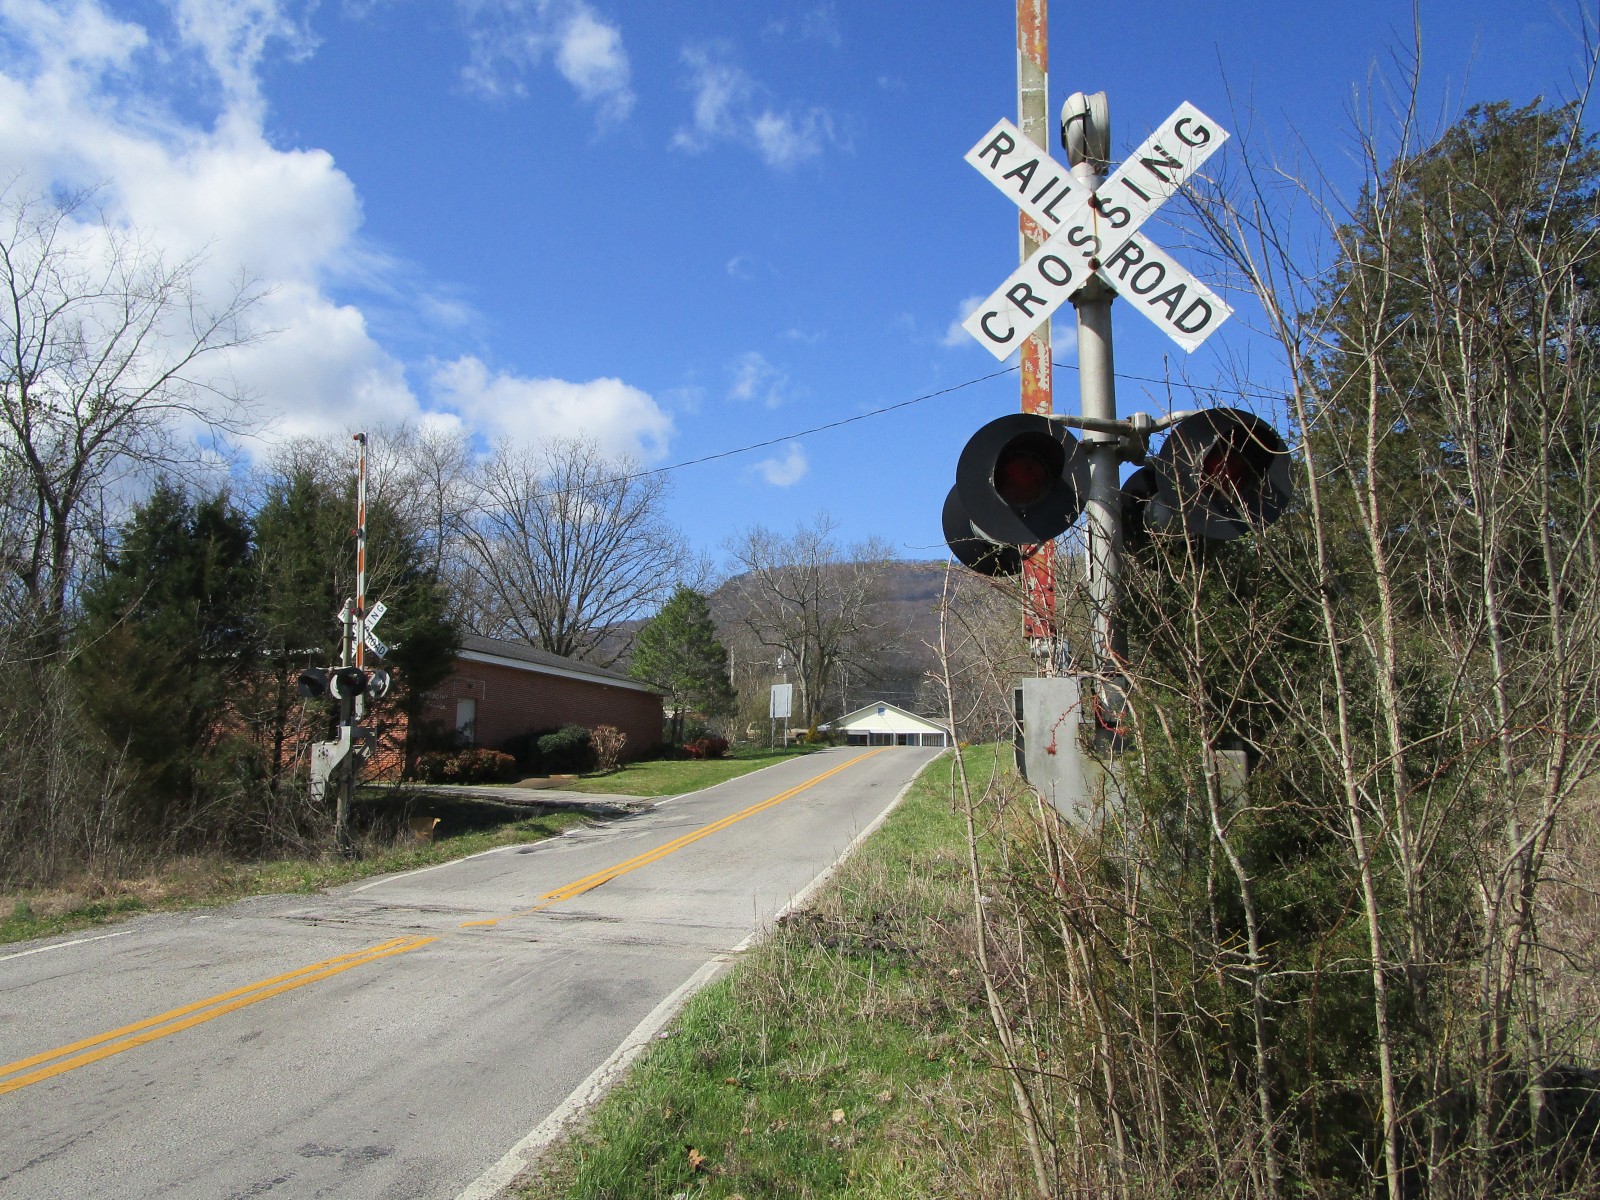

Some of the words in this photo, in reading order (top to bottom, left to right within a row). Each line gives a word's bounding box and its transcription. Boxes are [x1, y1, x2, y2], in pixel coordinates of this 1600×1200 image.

[977, 130, 1072, 225] RAIL
[1105, 239, 1213, 334] ROAD
[980, 117, 1211, 344] CROSSING
